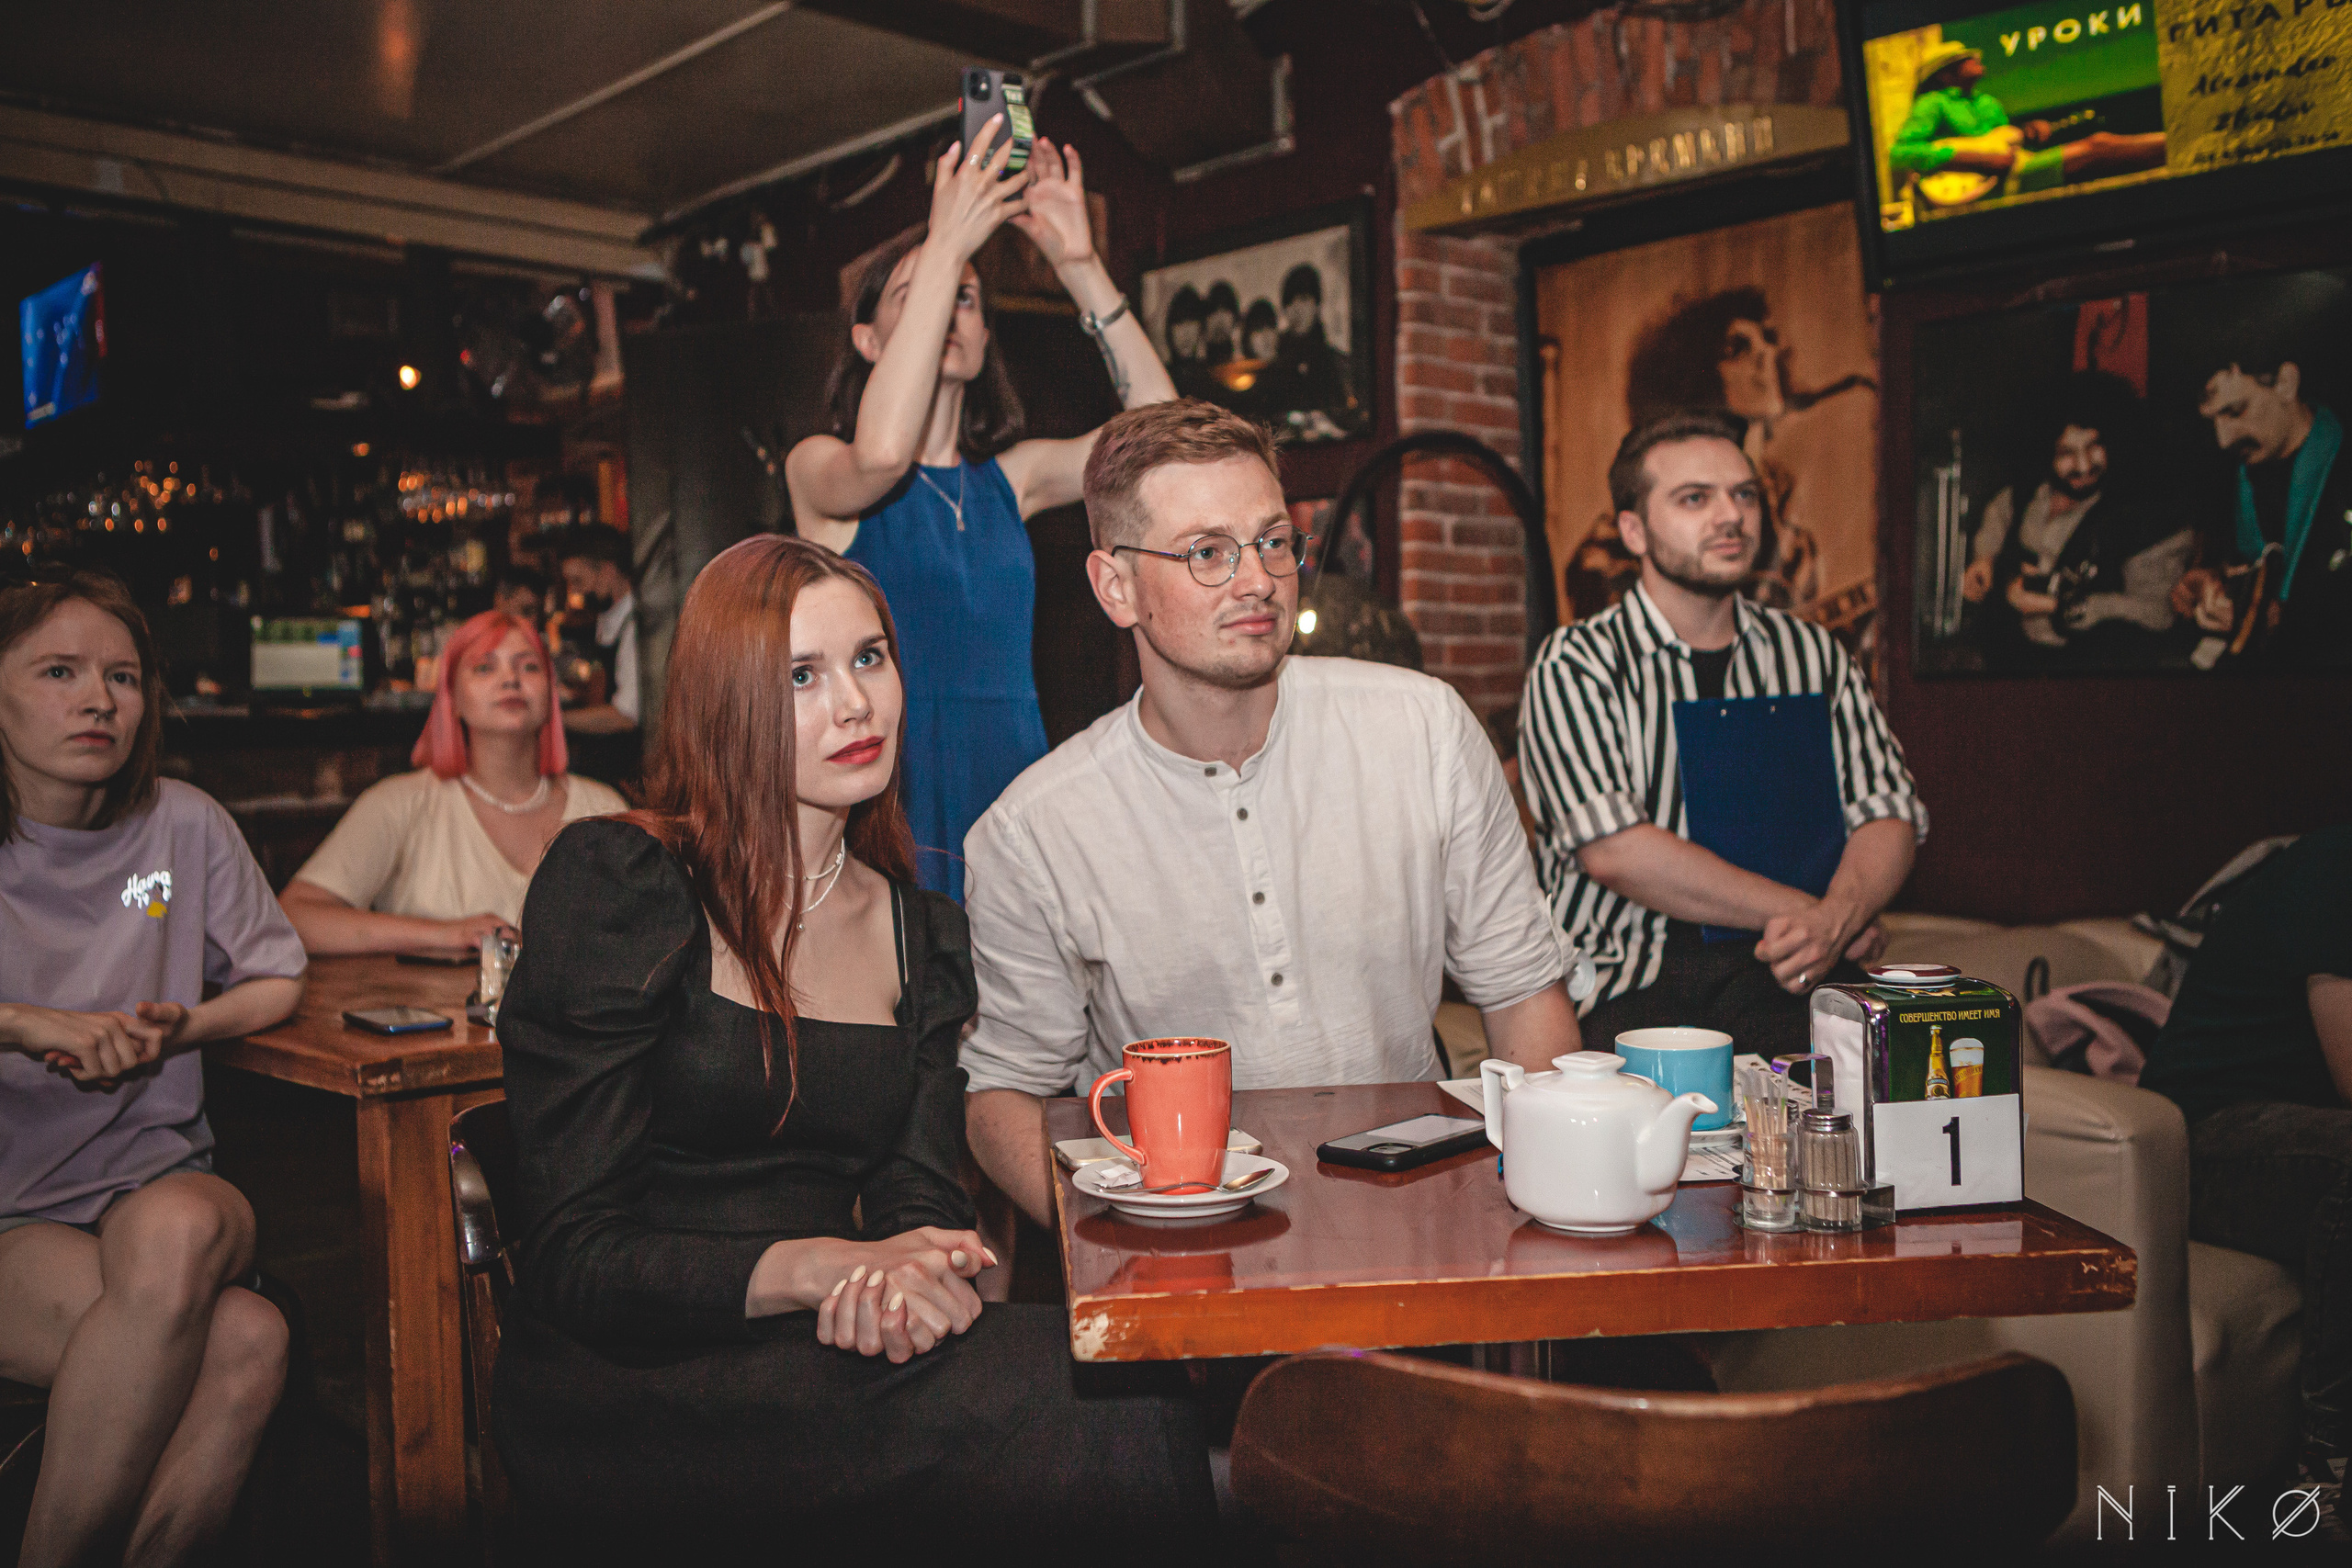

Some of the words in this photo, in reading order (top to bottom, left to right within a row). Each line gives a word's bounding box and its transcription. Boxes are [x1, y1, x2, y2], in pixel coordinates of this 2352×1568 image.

[1999, 3, 2142, 57] УРОКИ
[1899, 1011, 1957, 1023] СОВЕРШЕНСТВО
[1958, 1010, 1982, 1021] ИМЕЕТ
[1984, 1009, 2001, 1019] ИМЯ
[1942, 1116, 1962, 1186] 1
